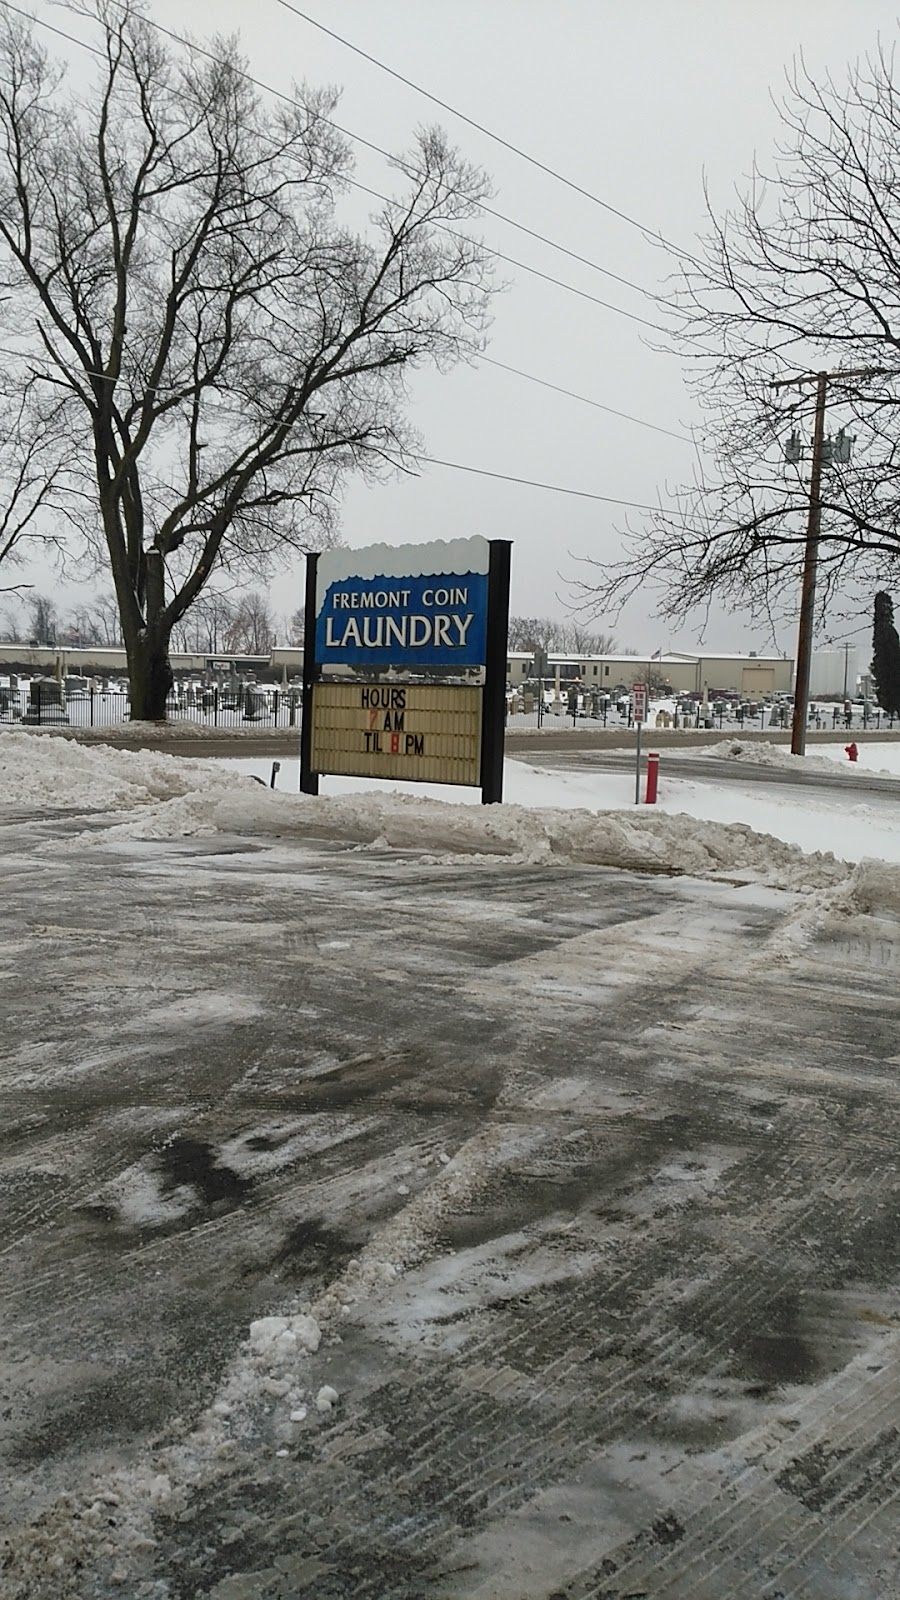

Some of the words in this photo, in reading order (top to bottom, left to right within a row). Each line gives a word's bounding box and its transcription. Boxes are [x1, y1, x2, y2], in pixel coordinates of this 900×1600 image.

[333, 590, 410, 609] FREMONT
[422, 588, 468, 606] COIN
[325, 614, 475, 648] LAUNDRY
[361, 688, 407, 709] HOURS
[369, 709, 378, 730] 7
[383, 711, 405, 731] AM
[364, 732, 382, 752] TIL
[391, 733, 399, 755] 8
[405, 734, 424, 755] PM
